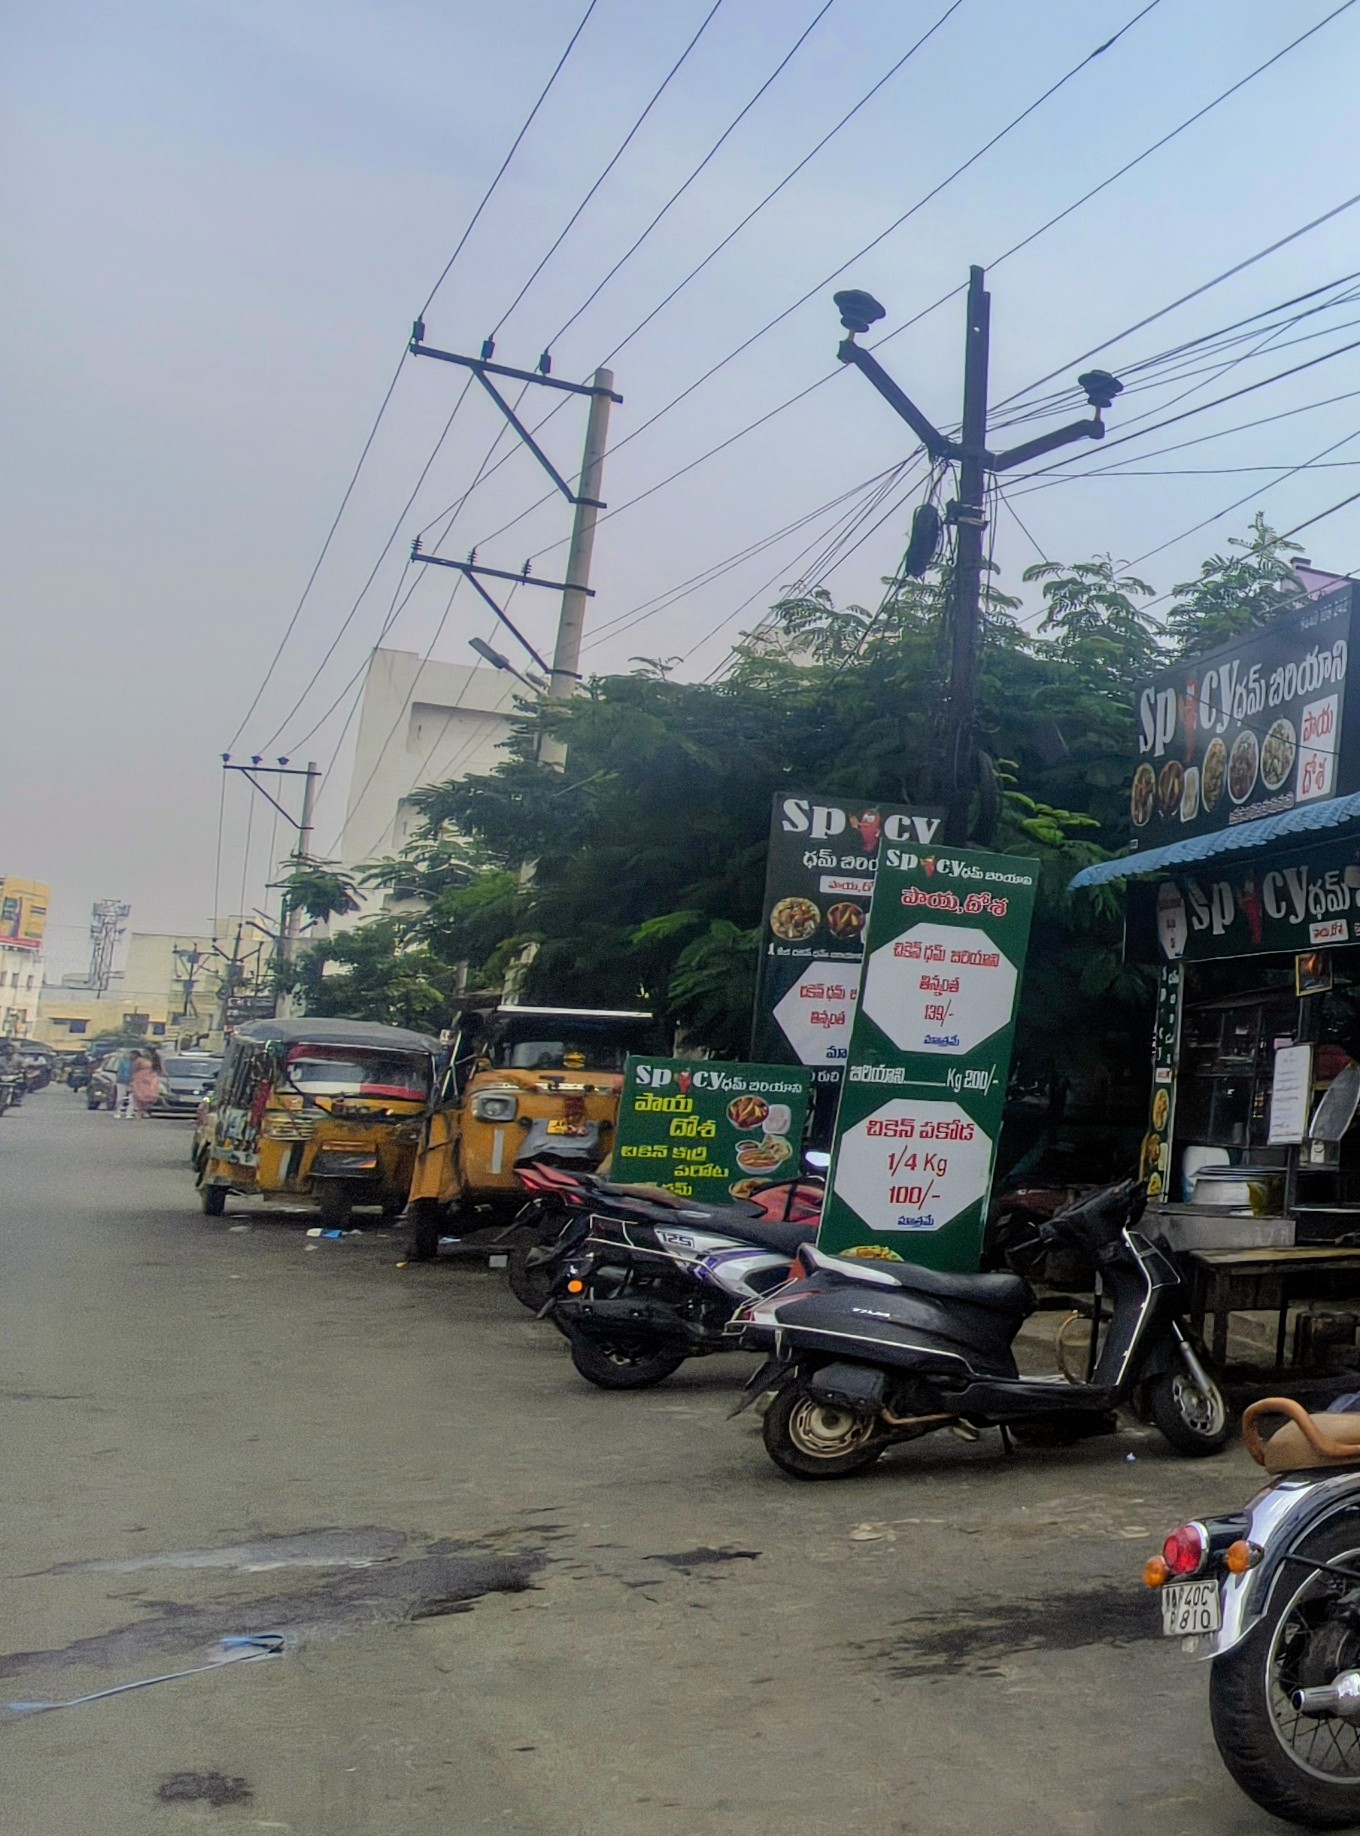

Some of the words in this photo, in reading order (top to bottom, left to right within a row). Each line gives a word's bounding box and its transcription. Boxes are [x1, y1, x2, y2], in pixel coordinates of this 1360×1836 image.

[887, 1144, 917, 1177] 1/4
[923, 1152, 948, 1177] Kg
[889, 1179, 941, 1211] 100/-
